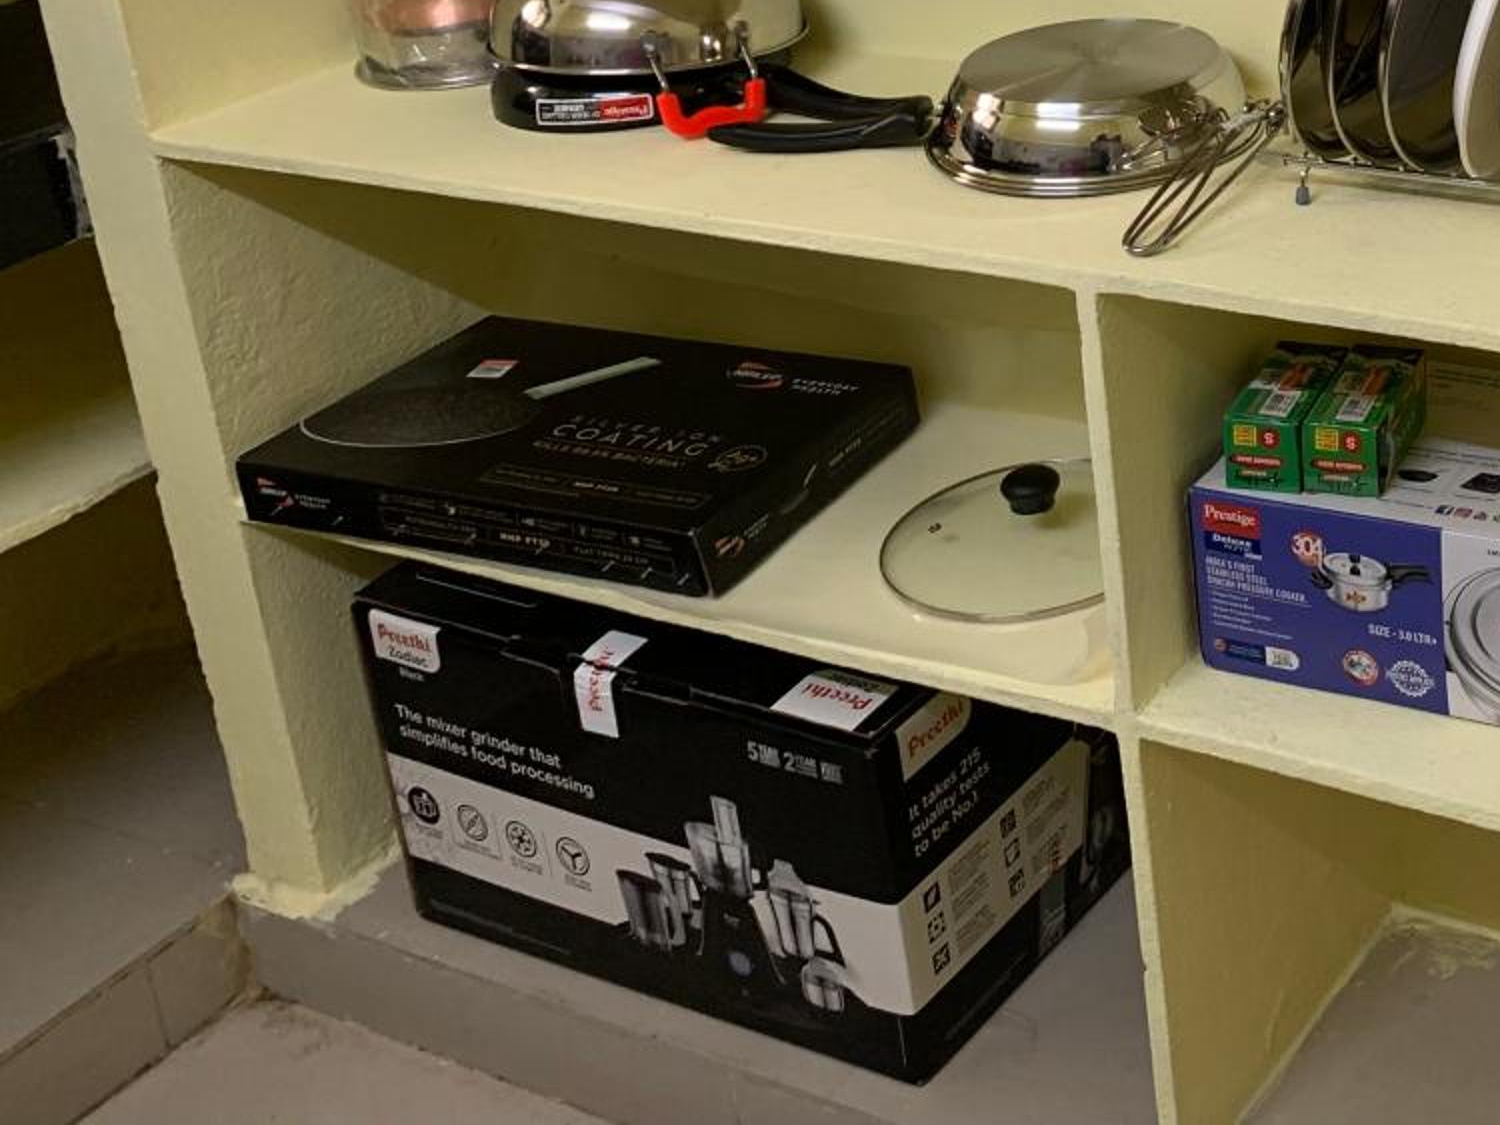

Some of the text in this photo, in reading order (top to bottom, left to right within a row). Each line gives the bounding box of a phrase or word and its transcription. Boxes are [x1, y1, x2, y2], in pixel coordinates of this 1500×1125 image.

[552, 424, 708, 456] COATING
[1204, 503, 1257, 526] Prestige
[378, 623, 432, 652] Preethi
[800, 682, 874, 711] Preethi
[395, 703, 562, 769] The mixer grinder that
[906, 699, 964, 759] Preethi
[400, 723, 595, 801] simplifies food processing
[908, 804, 920, 822] It
[911, 790, 957, 841] quality
[915, 839, 929, 858] to
[931, 820, 951, 842] be
